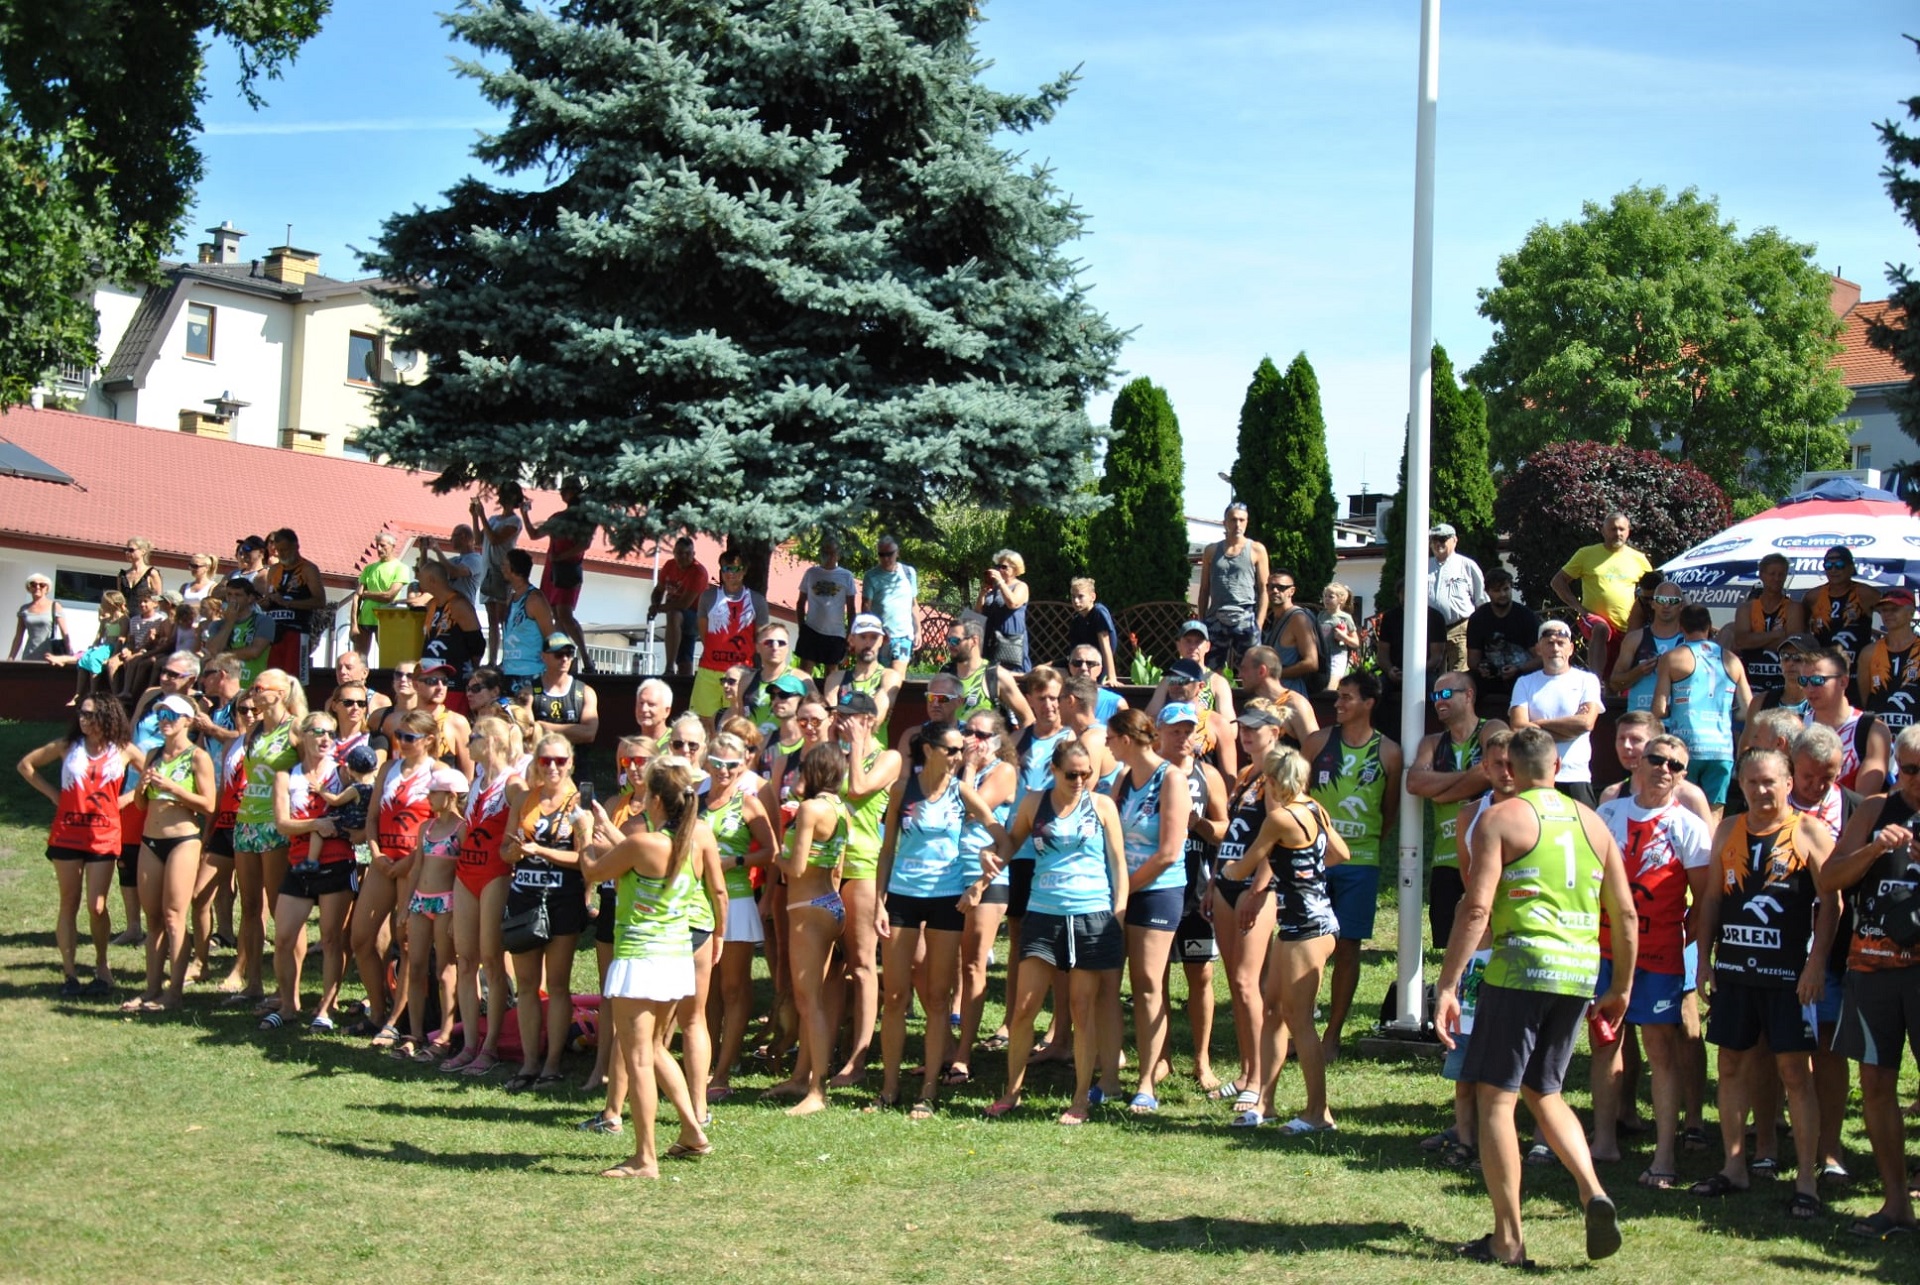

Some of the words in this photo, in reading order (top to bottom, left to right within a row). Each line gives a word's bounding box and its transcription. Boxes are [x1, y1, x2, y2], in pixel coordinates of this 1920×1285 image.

[1777, 535, 1874, 547] ice-mastry
[282, 573, 289, 586] 1
[1831, 601, 1841, 618] 2
[431, 612, 440, 628] 2
[233, 627, 242, 643] 2
[1892, 657, 1900, 676] 1
[1341, 754, 1356, 776] 2
[534, 818, 549, 842] 2
[1221, 844, 1244, 858] LEN
[1631, 829, 1642, 856] 1
[1554, 830, 1576, 889] 1
[1751, 842, 1763, 872] 1
[516, 871, 562, 886] ORLEN
